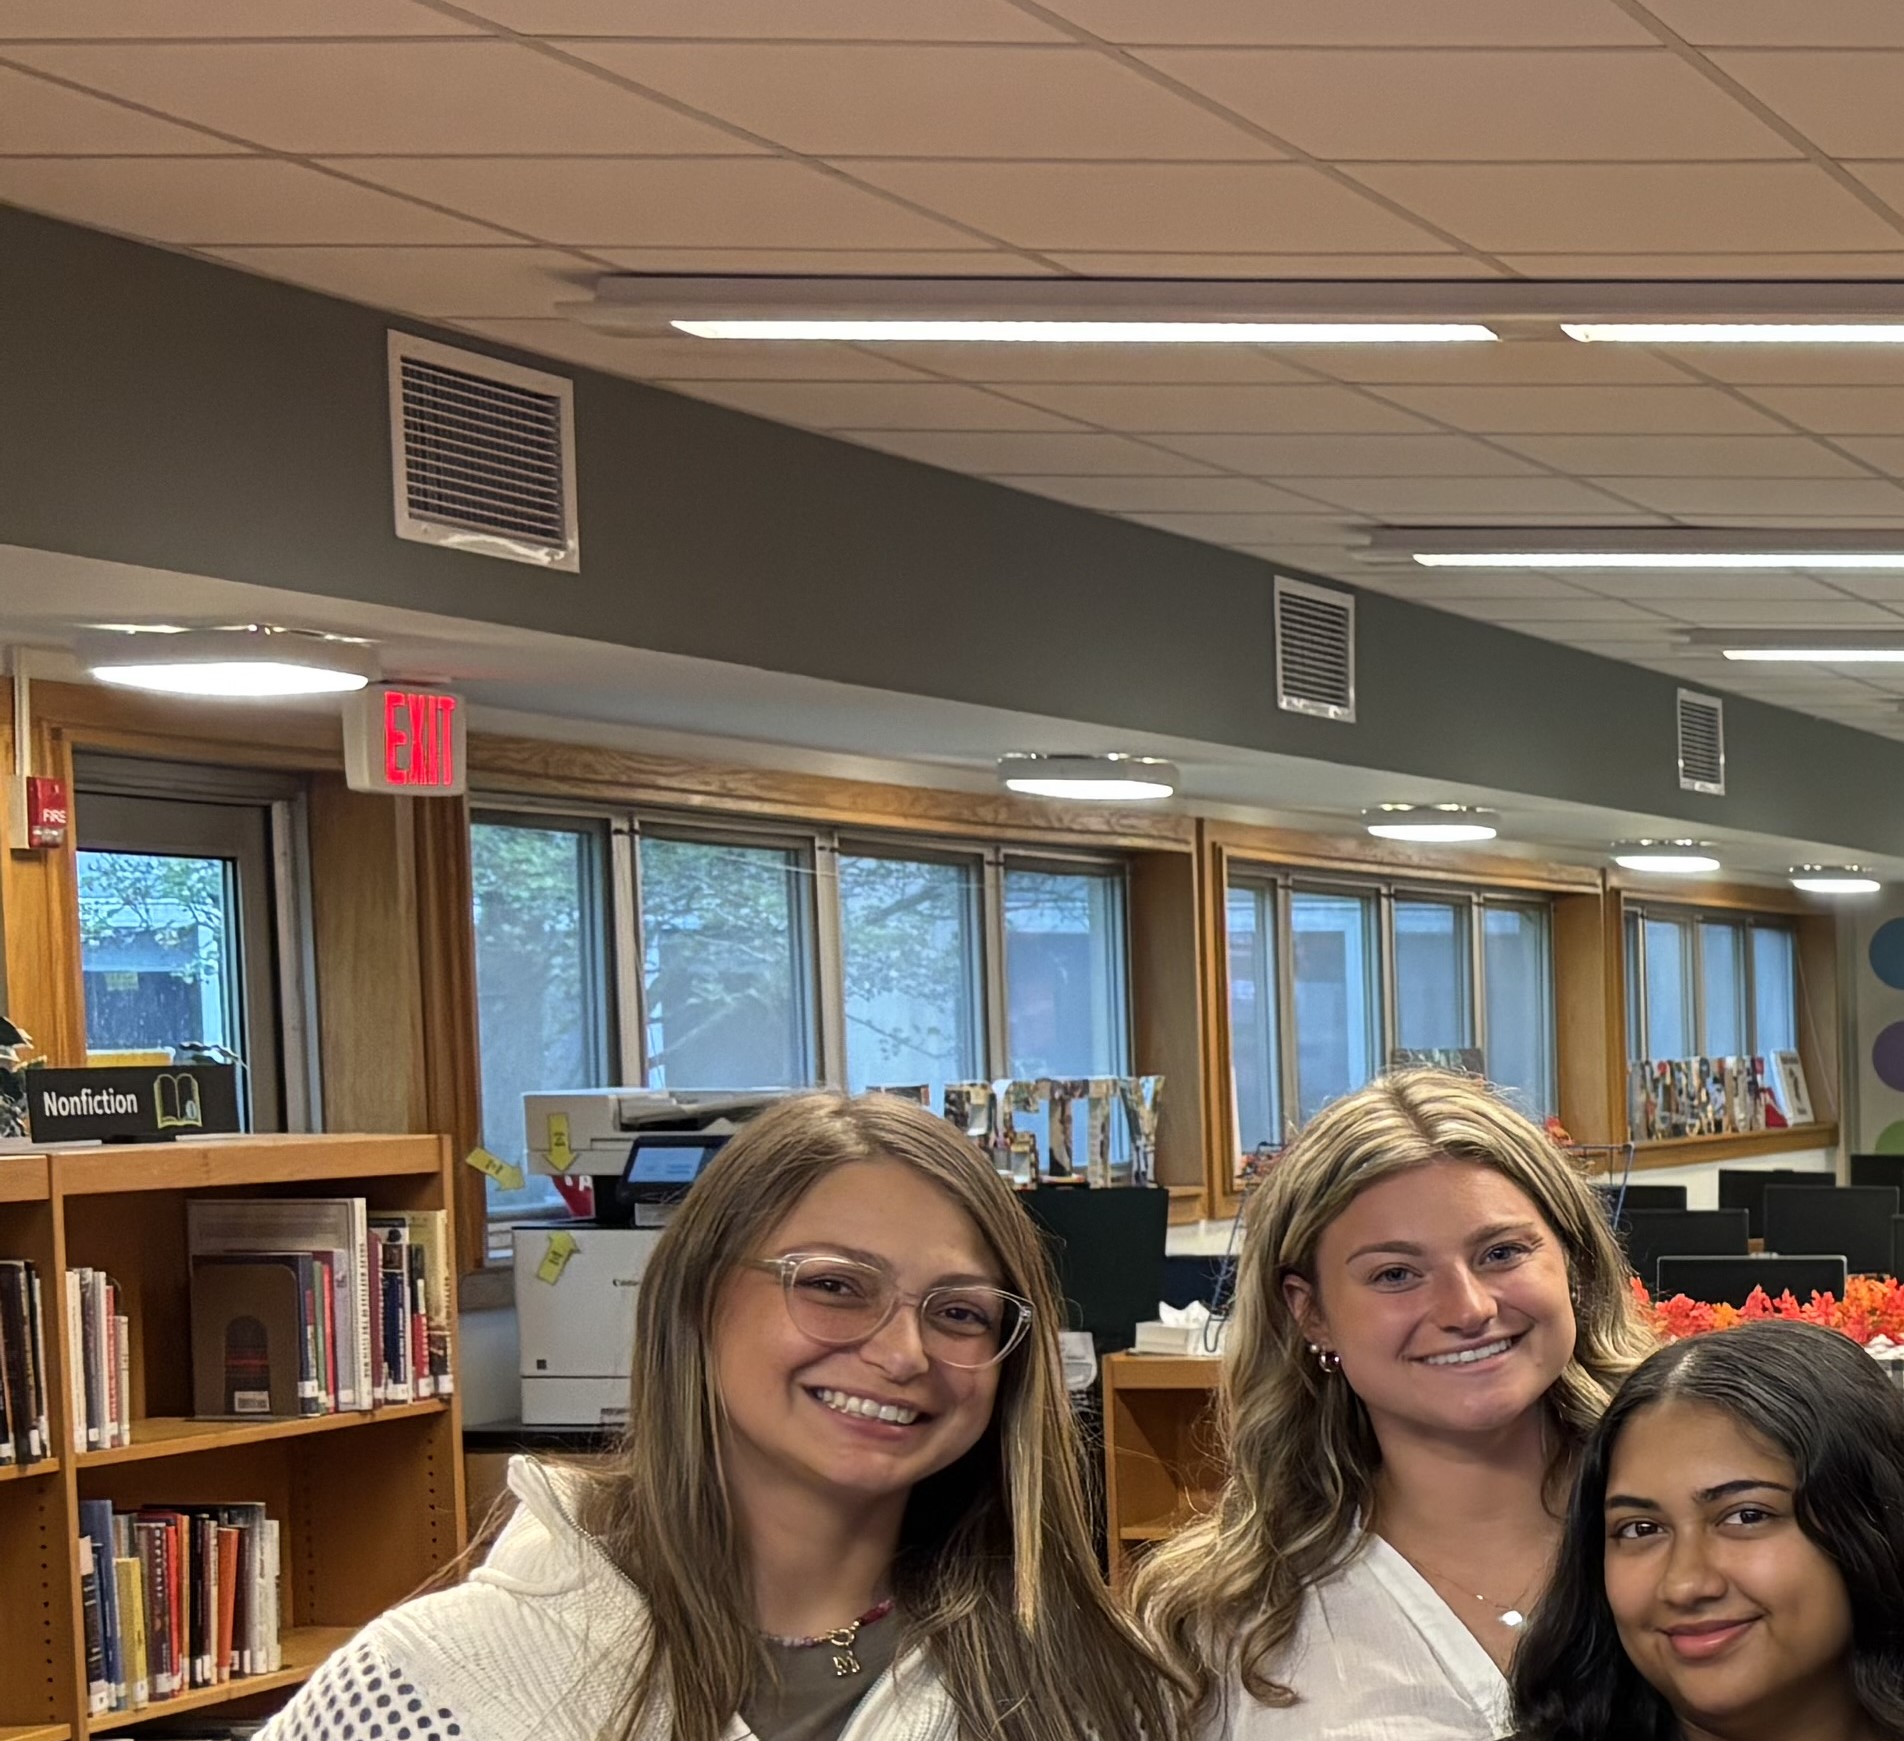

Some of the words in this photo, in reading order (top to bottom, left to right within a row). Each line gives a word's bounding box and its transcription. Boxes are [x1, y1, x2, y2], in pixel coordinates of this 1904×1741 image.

[384, 691, 456, 785] EXIT
[43, 808, 67, 823] FIRE
[43, 1087, 138, 1117] Nonfiction
